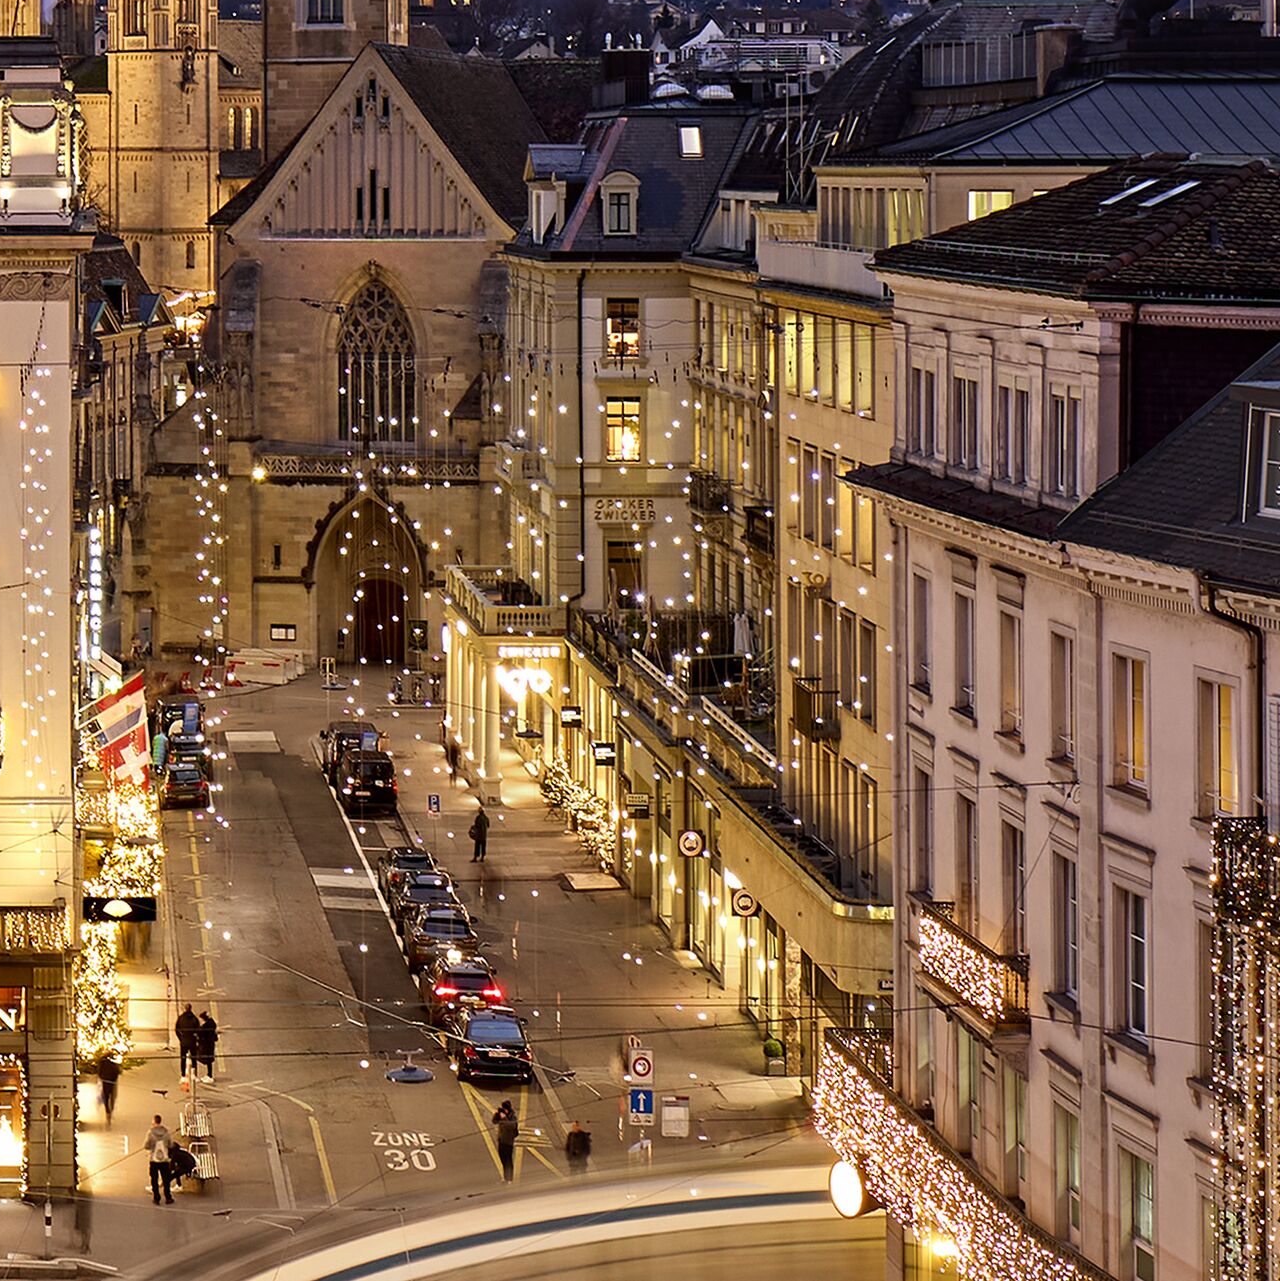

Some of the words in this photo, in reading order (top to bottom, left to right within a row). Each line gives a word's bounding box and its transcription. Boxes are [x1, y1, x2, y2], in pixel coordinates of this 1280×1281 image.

[594, 511, 656, 520] ZWICKER
[371, 1131, 435, 1147] ZONE
[384, 1149, 437, 1171] 30
